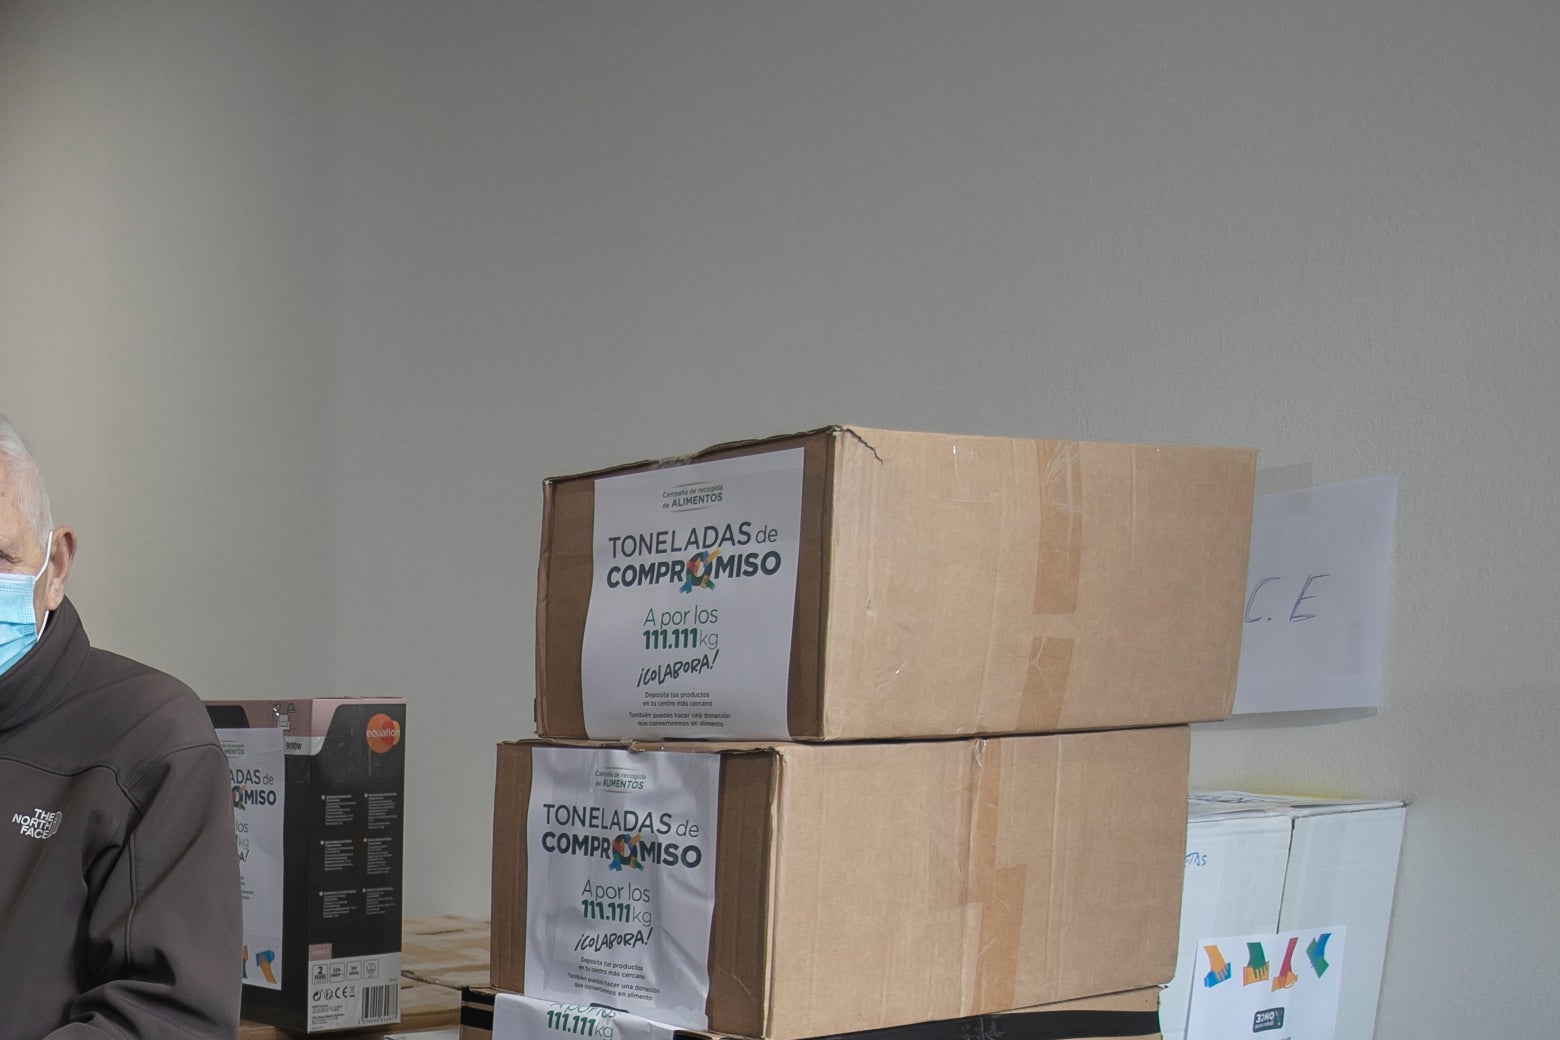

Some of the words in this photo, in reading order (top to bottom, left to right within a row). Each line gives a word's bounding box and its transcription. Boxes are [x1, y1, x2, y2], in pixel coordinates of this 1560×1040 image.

[672, 493, 723, 507] ALIMENTOS
[608, 521, 752, 558] TONELADAS
[755, 525, 778, 544] de
[607, 551, 781, 588] COMPROMISO
[643, 608, 656, 626] A
[660, 609, 690, 629] por
[694, 605, 718, 624] los
[366, 729, 400, 738] equation
[263, 773, 274, 785] de
[12, 814, 52, 830] NORTH
[34, 808, 55, 821] THE
[543, 804, 672, 835] TONELADAS
[676, 820, 699, 837] de
[20, 826, 49, 839] FACE
[542, 832, 702, 868] COMPROMISO
[581, 879, 592, 896] A
[595, 884, 624, 901] por
[628, 882, 650, 902] los
